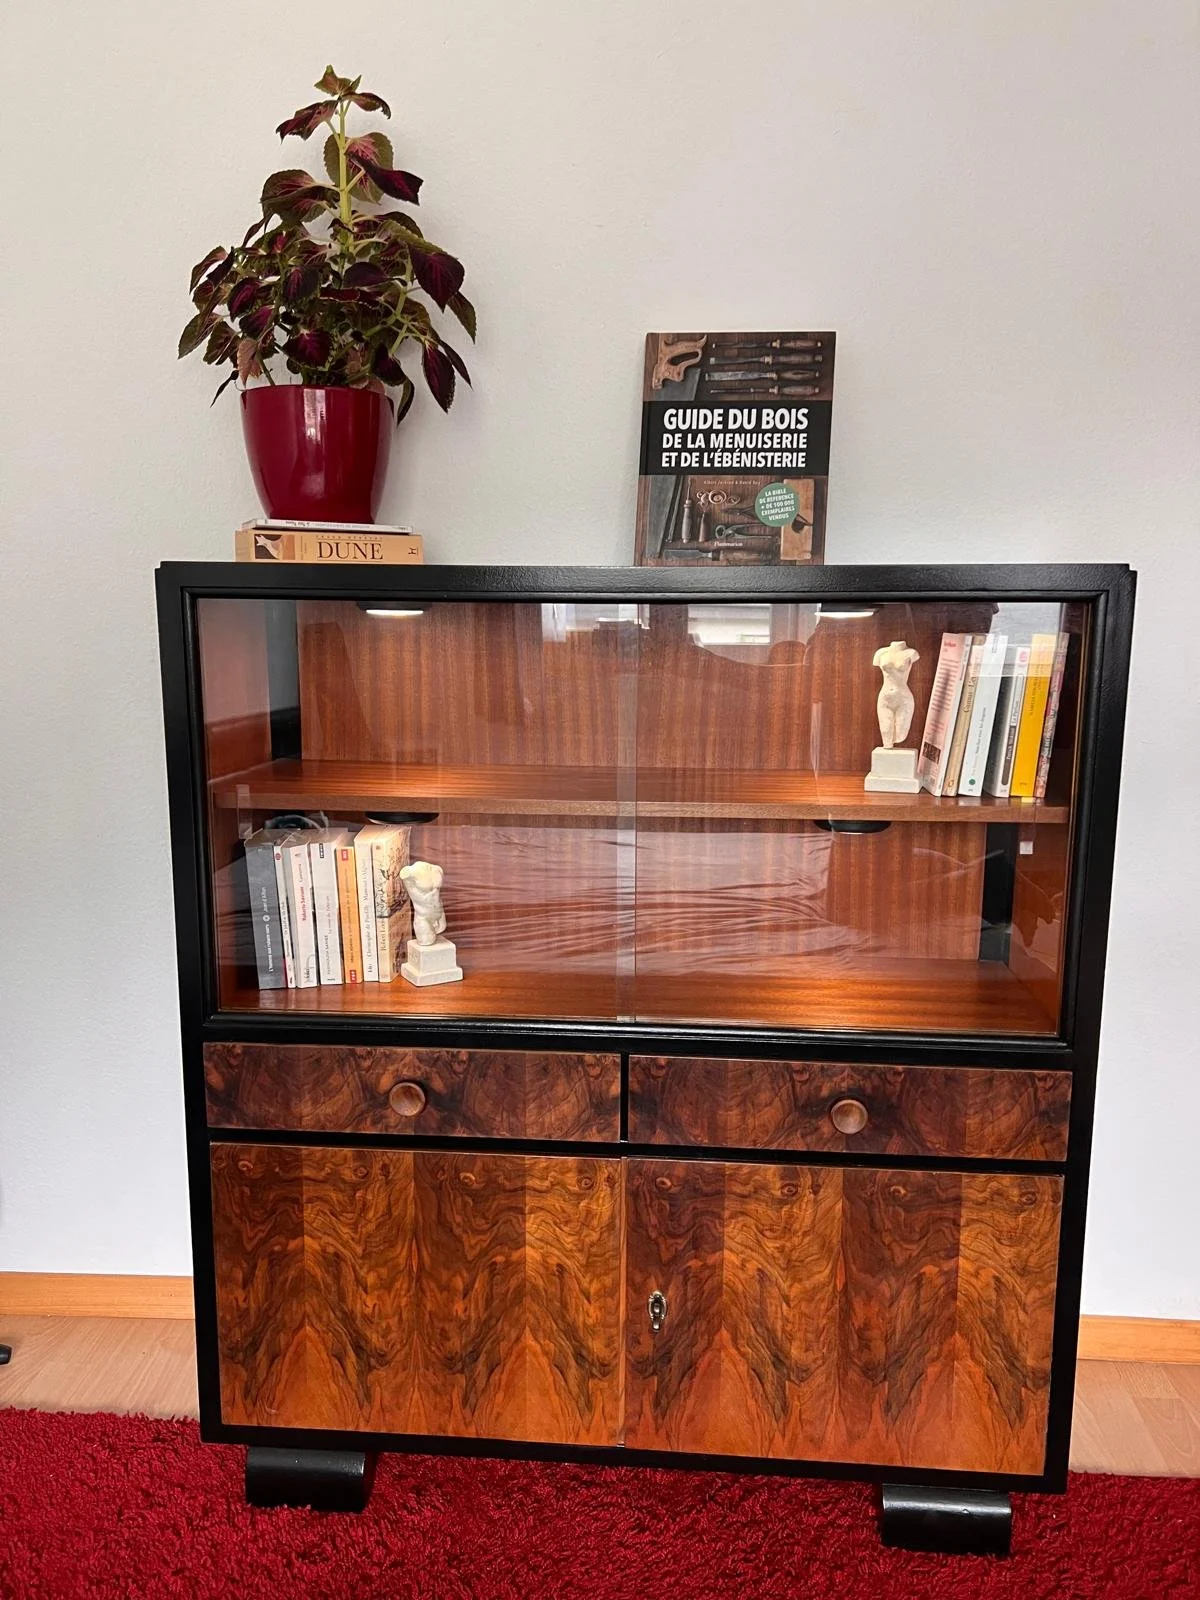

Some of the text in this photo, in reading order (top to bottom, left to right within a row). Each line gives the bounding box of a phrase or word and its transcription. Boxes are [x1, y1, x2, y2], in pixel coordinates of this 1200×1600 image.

[664, 408, 808, 430] GUIDE DU BOIS
[663, 433, 807, 448] DE LA MENUISERIE
[662, 449, 806, 468] ET DE L'ÉBÉNISTERIE
[769, 513, 789, 521] VENDUS
[317, 541, 383, 560] DUNE
